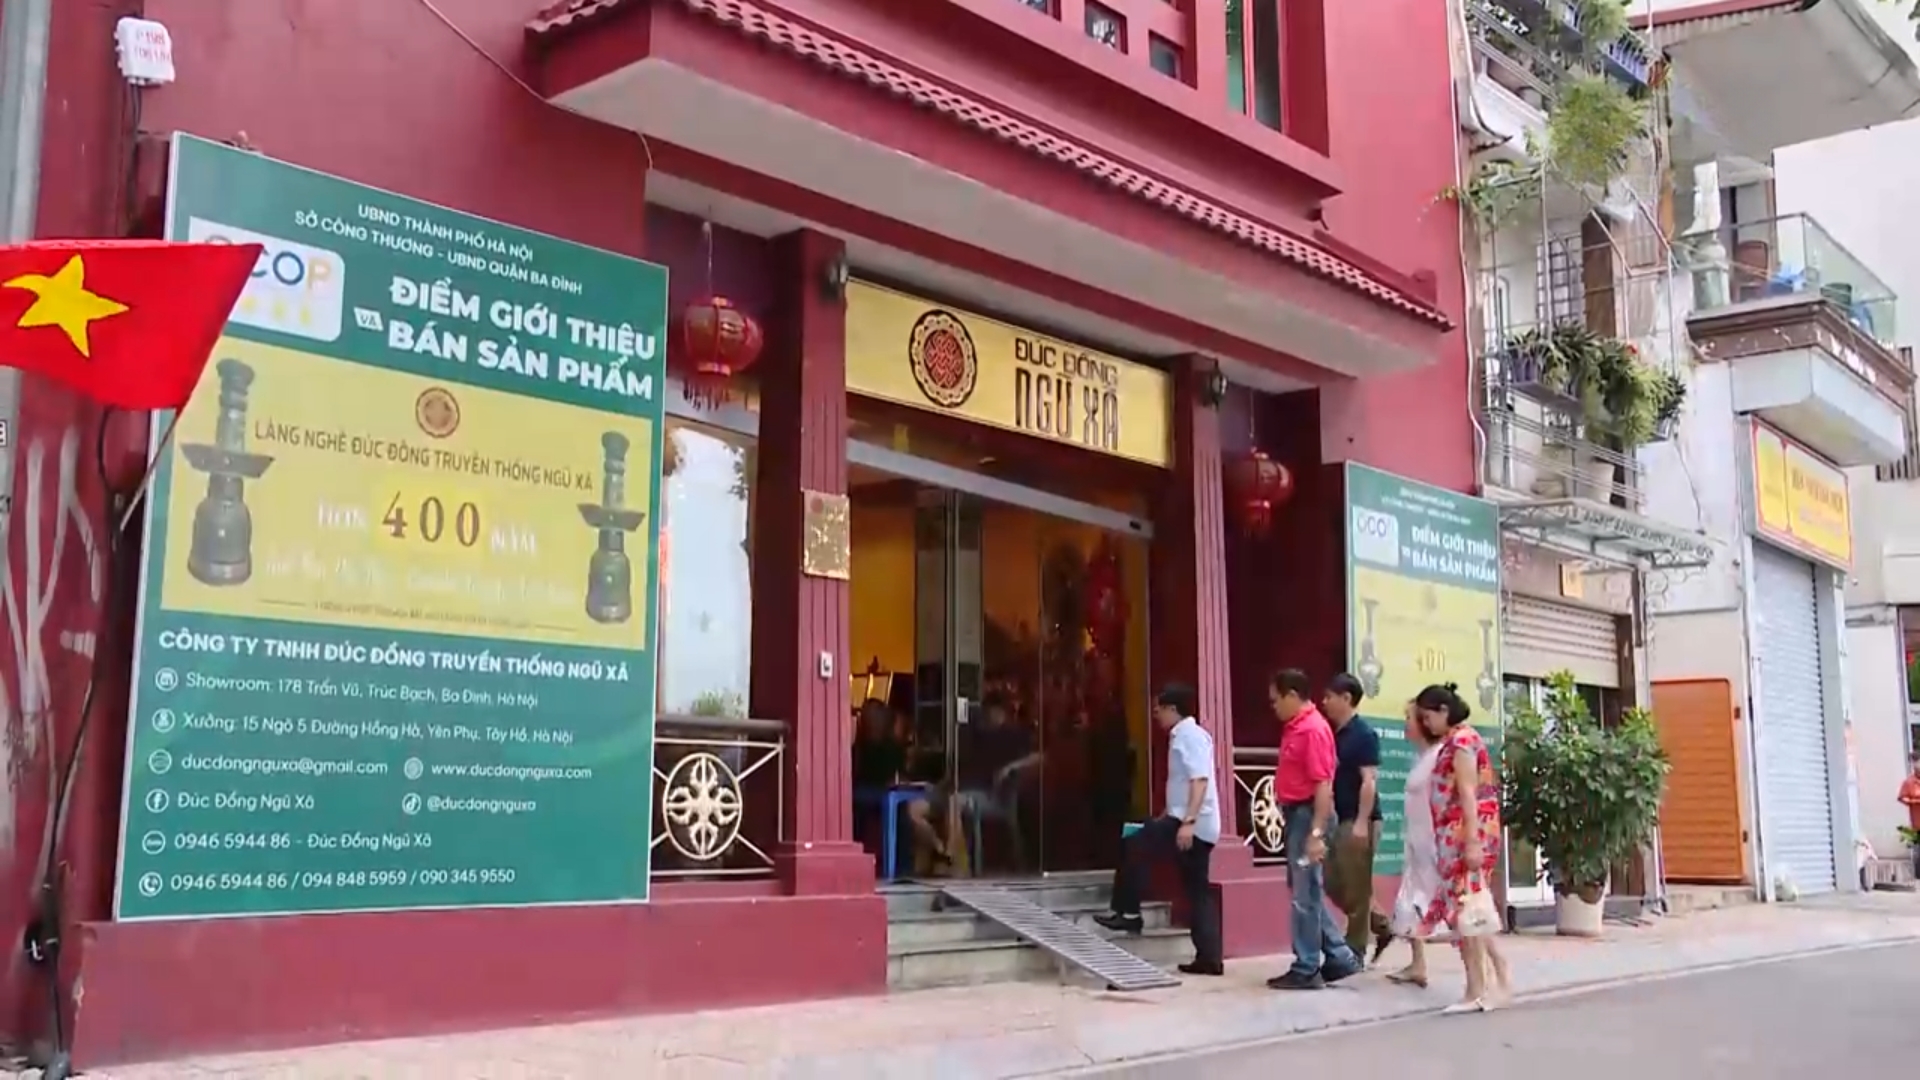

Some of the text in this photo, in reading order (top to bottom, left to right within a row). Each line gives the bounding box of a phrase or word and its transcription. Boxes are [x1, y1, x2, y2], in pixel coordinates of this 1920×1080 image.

[295, 209, 318, 228] SỞ
[321, 217, 367, 241] CÔNG
[371, 230, 433, 257] THƯƠNG
[447, 250, 487, 271] UBND
[488, 262, 528, 283] QUẬN
[530, 271, 548, 287] BA
[551, 275, 582, 295] ĐÌNH
[358, 204, 533, 263] UBND THÀNH PHỐ HÀ NỘI
[389, 276, 480, 322] ĐIỂM
[489, 302, 557, 339] GIỚI
[389, 320, 652, 400] BÁN SẢN PHẨM
[255, 417, 300, 445] LÀNG
[351, 434, 384, 459] ĐÚC
[381, 490, 480, 547] 400
[158, 627, 225, 652] CÔNG
[230, 635, 259, 654] TY
[264, 639, 319, 660] TNHH
[324, 640, 366, 663] ĐÚC
[506, 652, 565, 677] THỐNG
[186, 671, 272, 692] Showroom:
[279, 678, 302, 694] 178
[367, 683, 397, 699] Trúc
[442, 687, 460, 703] Ba
[497, 691, 515, 706] Hà
[517, 693, 538, 711] Nội
[243, 715, 259, 731] 15
[298, 718, 306, 731] 5
[311, 719, 358, 739] Đường
[427, 722, 450, 740] Yên
[486, 726, 508, 745] Tây
[533, 728, 550, 743] Hà
[552, 729, 573, 747] Nội
[181, 753, 388, 776] ducdongnguxa@gmail.com
[431, 762, 592, 782] www.ducdongnguxa.com
[177, 791, 210, 808] Đúc
[427, 795, 536, 814] @ducdongnguxa
[174, 833, 219, 849] 0946
[224, 833, 265, 849] 5944
[270, 833, 291, 848] 86
[307, 832, 337, 848] Đúc
[171, 868, 515, 890] 0946 5944 86 / 094 848 5959 / 090 345 9550
